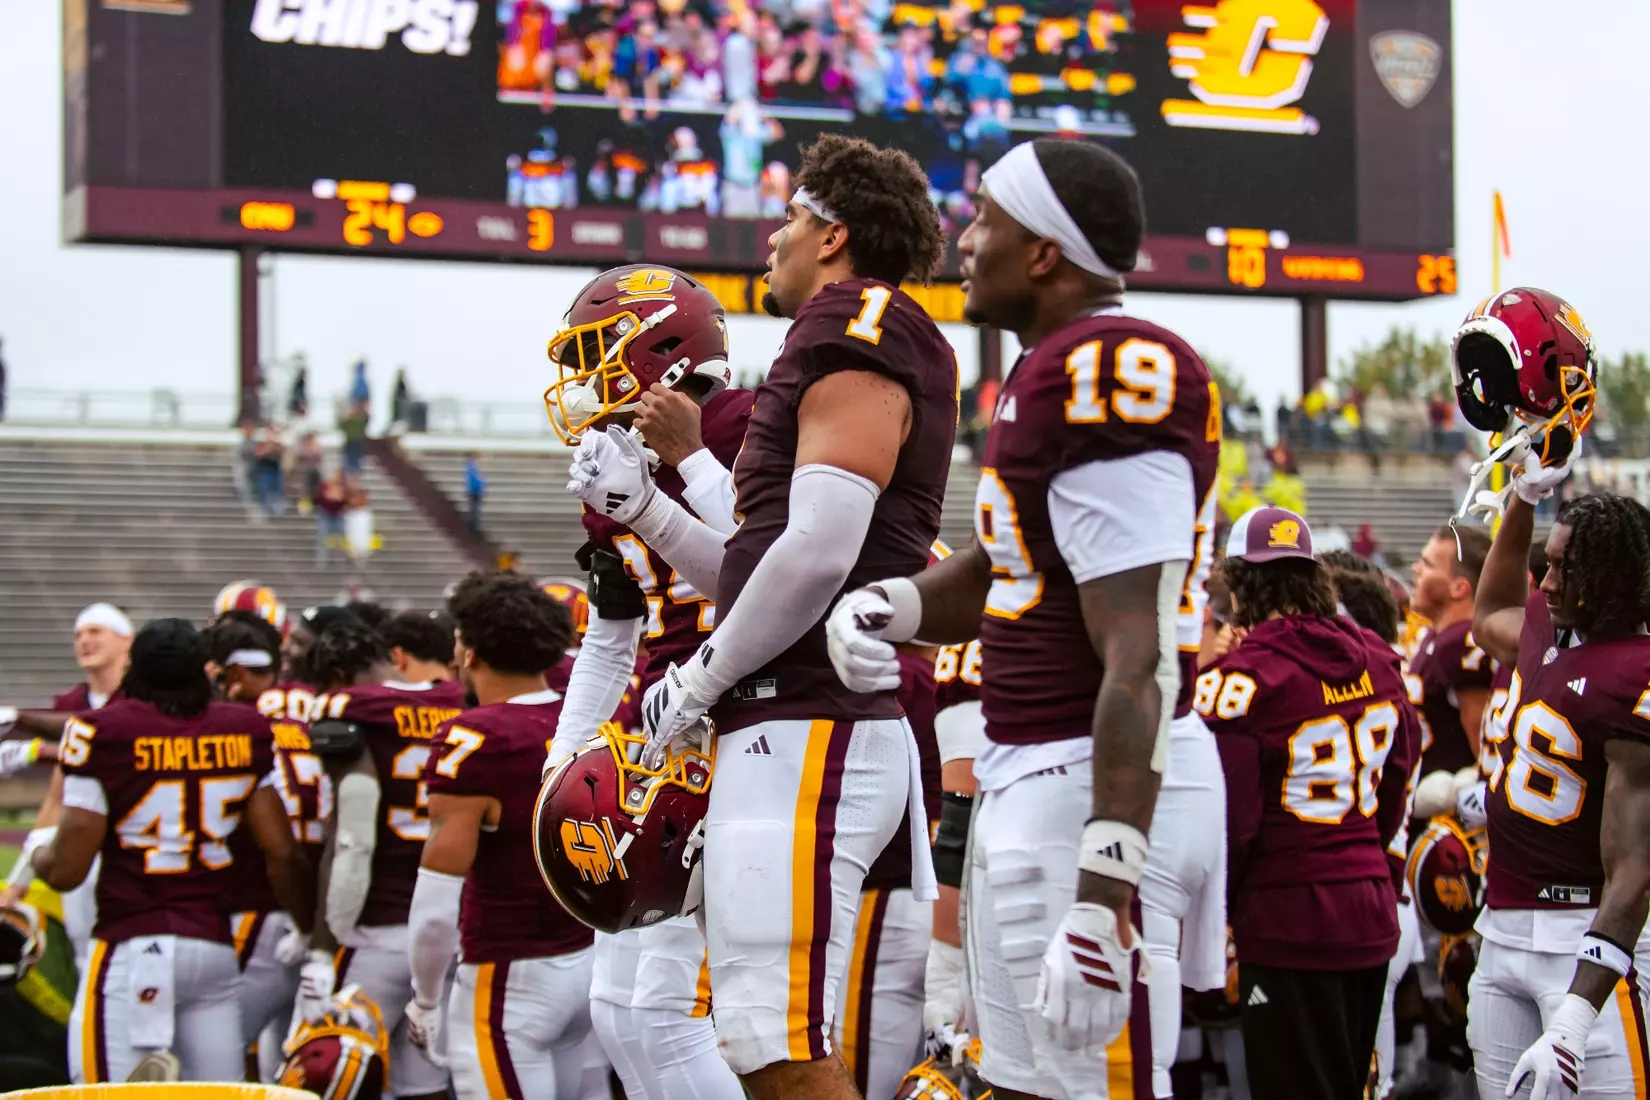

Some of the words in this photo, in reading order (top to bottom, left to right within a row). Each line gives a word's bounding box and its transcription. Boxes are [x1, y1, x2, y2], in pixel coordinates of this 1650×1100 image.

[250, 0, 478, 56] CHIPS!
[343, 199, 406, 246] 24
[527, 209, 555, 251] 3
[845, 285, 893, 346] 1
[1064, 337, 1177, 424] 19
[1193, 667, 1258, 720] 88
[58, 716, 97, 767] 5
[133, 734, 251, 771] STAPLETON
[435, 724, 485, 780] 7
[1281, 700, 1399, 825] 88
[115, 774, 257, 875] 45
